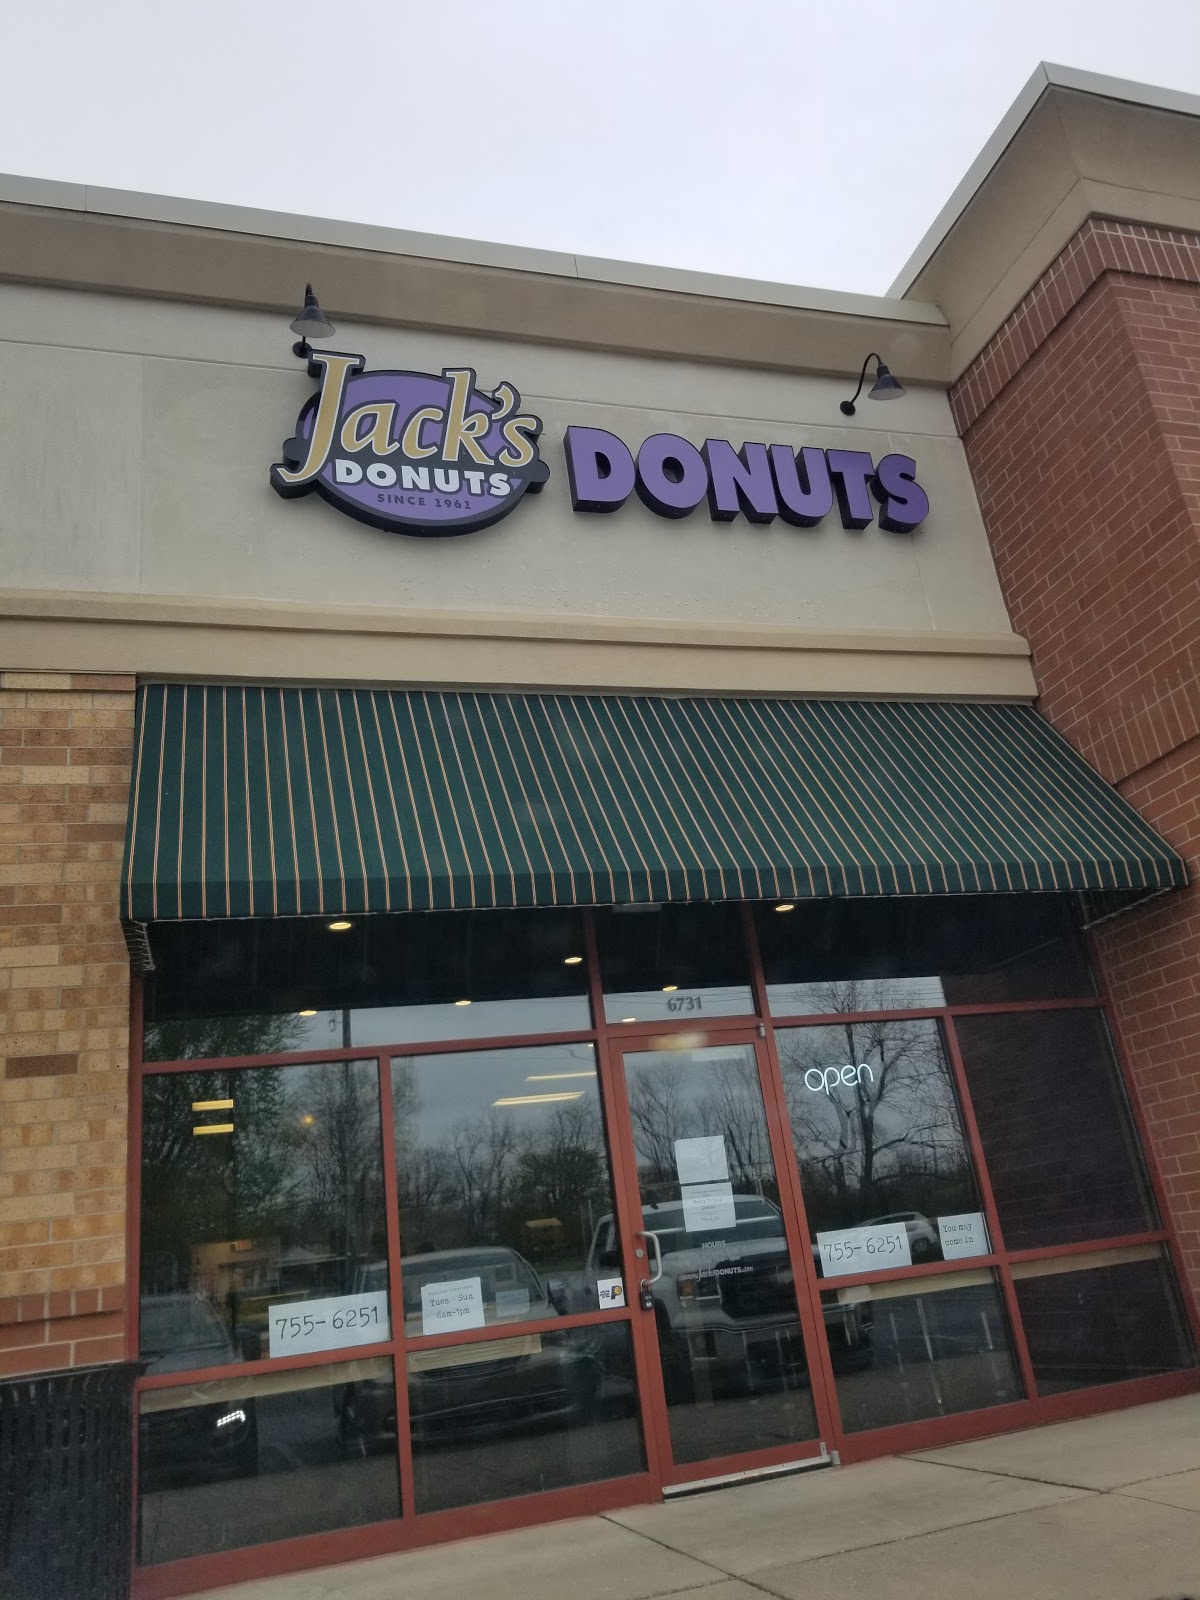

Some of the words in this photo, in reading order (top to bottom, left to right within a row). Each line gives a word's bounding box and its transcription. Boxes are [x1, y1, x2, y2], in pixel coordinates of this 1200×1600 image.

[276, 353, 537, 483] Jack's
[334, 458, 512, 497] DONUTS
[563, 425, 929, 533] DONUTS
[376, 493, 426, 507] SINCE
[434, 497, 473, 511] 1961
[666, 996, 703, 1012] 6731
[804, 1063, 874, 1096] open
[942, 1224, 957, 1233] You
[958, 1223, 973, 1232] may
[701, 1240, 727, 1250] HOURS
[944, 1238, 964, 1246] come
[964, 1235, 974, 1244] in
[429, 1298, 450, 1307] Tues
[458, 1293, 474, 1302] Sun
